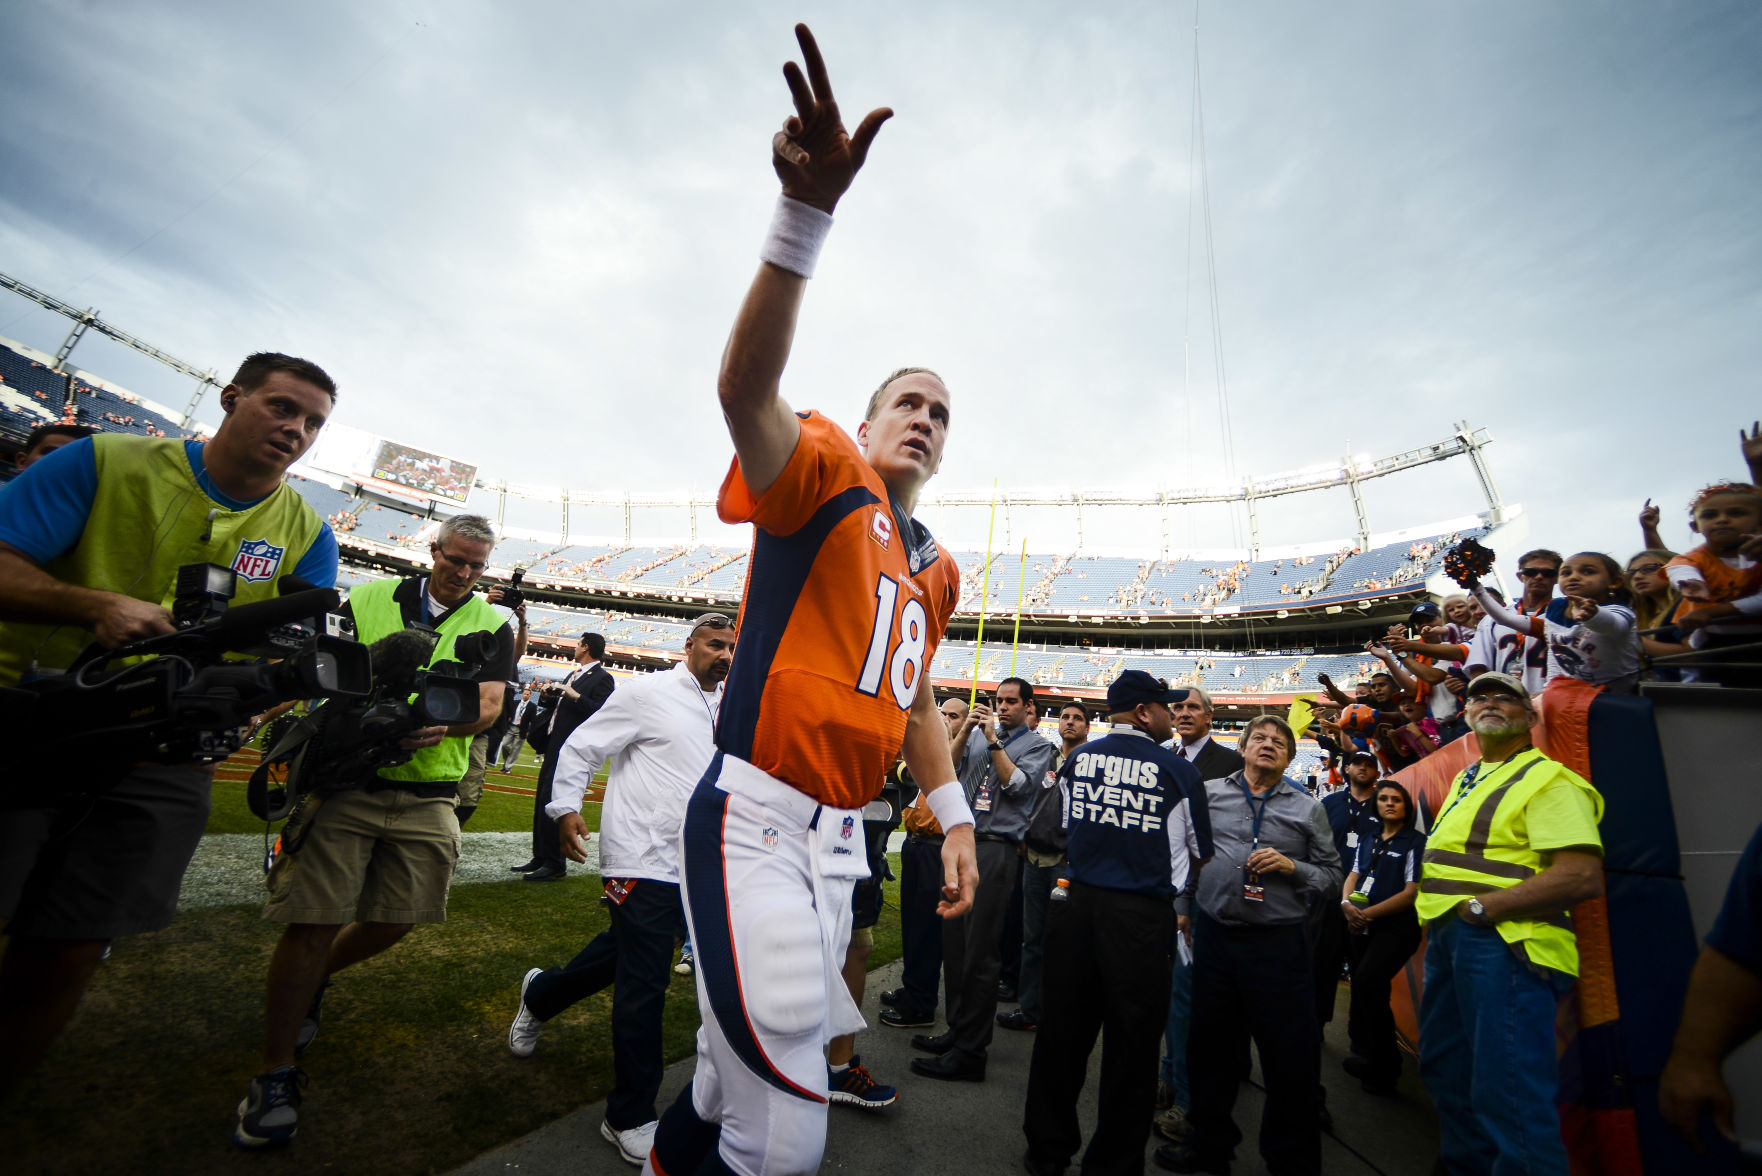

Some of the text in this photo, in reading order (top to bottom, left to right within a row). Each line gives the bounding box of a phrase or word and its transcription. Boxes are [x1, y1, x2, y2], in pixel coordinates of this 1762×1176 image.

[872, 511, 891, 541] C
[235, 553, 271, 577] NFL
[855, 571, 927, 712] 18
[1499, 633, 1548, 678] 24
[1074, 752, 1159, 789] argus
[1072, 781, 1164, 813] EVENT
[1071, 800, 1162, 833] STAFF
[763, 836, 777, 846] NFL
